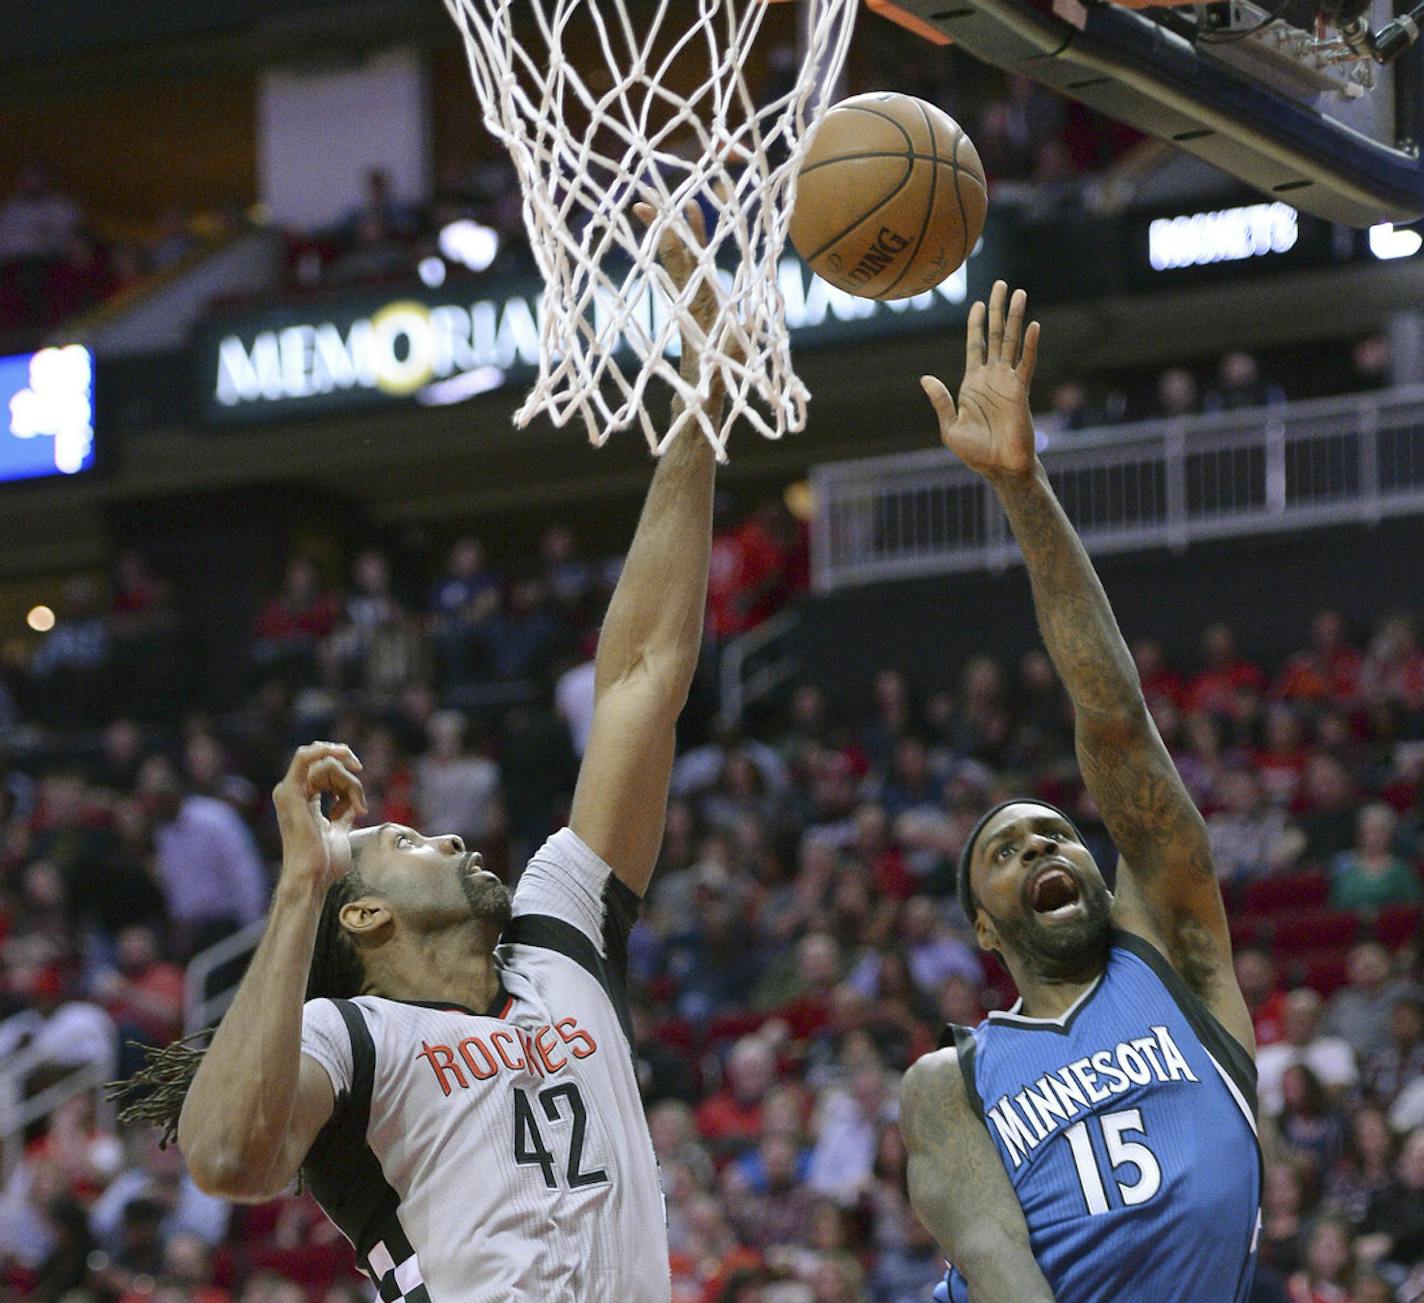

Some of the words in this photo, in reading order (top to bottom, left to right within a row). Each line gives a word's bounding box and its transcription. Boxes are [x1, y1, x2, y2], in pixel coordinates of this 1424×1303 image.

[513, 1081, 609, 1189] 42
[987, 1025, 1200, 1170] MINNESOTA
[1063, 1107, 1162, 1216] 15
